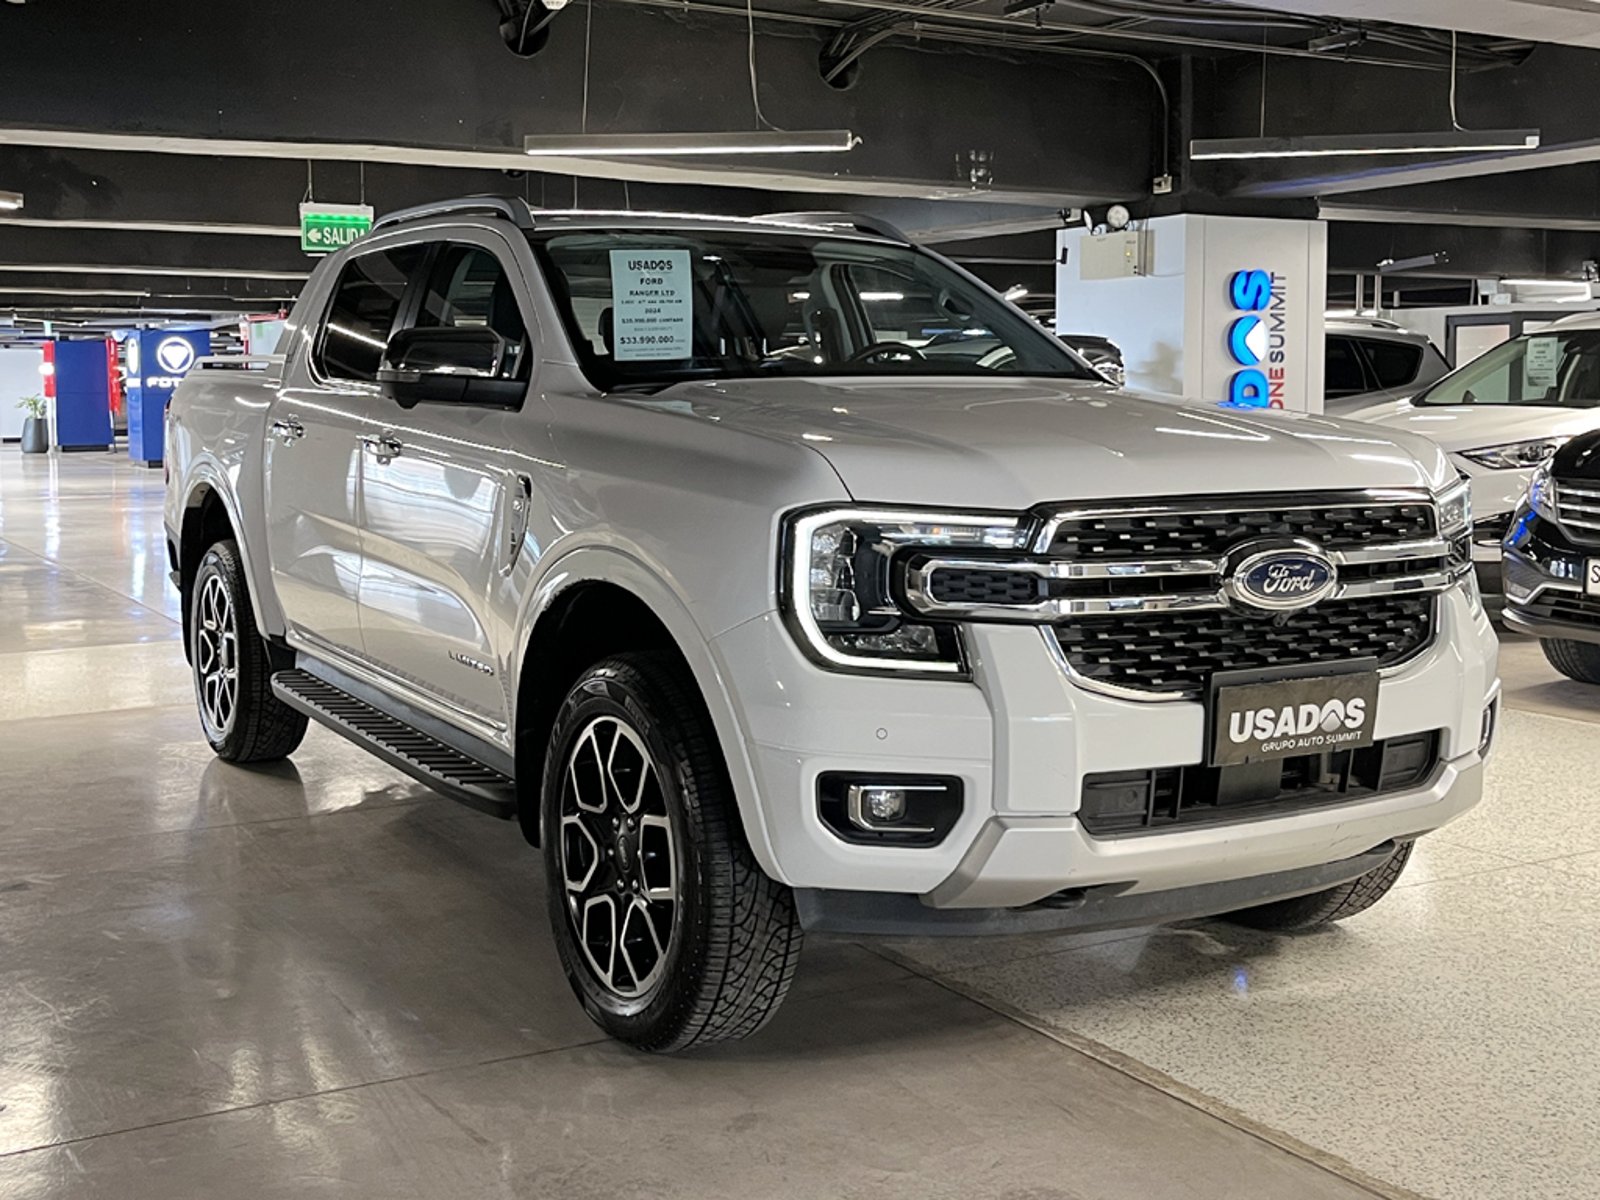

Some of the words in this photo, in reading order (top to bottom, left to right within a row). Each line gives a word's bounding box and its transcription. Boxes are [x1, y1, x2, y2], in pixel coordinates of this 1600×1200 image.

[628, 260, 673, 270] USADOS
[1269, 271, 1286, 363] SUMMIT
[1263, 563, 1316, 594] Ford
[1229, 698, 1366, 743] USADOS
[1261, 739, 1296, 753] GRUPO
[1297, 736, 1324, 747] AUTO
[1325, 731, 1362, 744] SUMMIT
